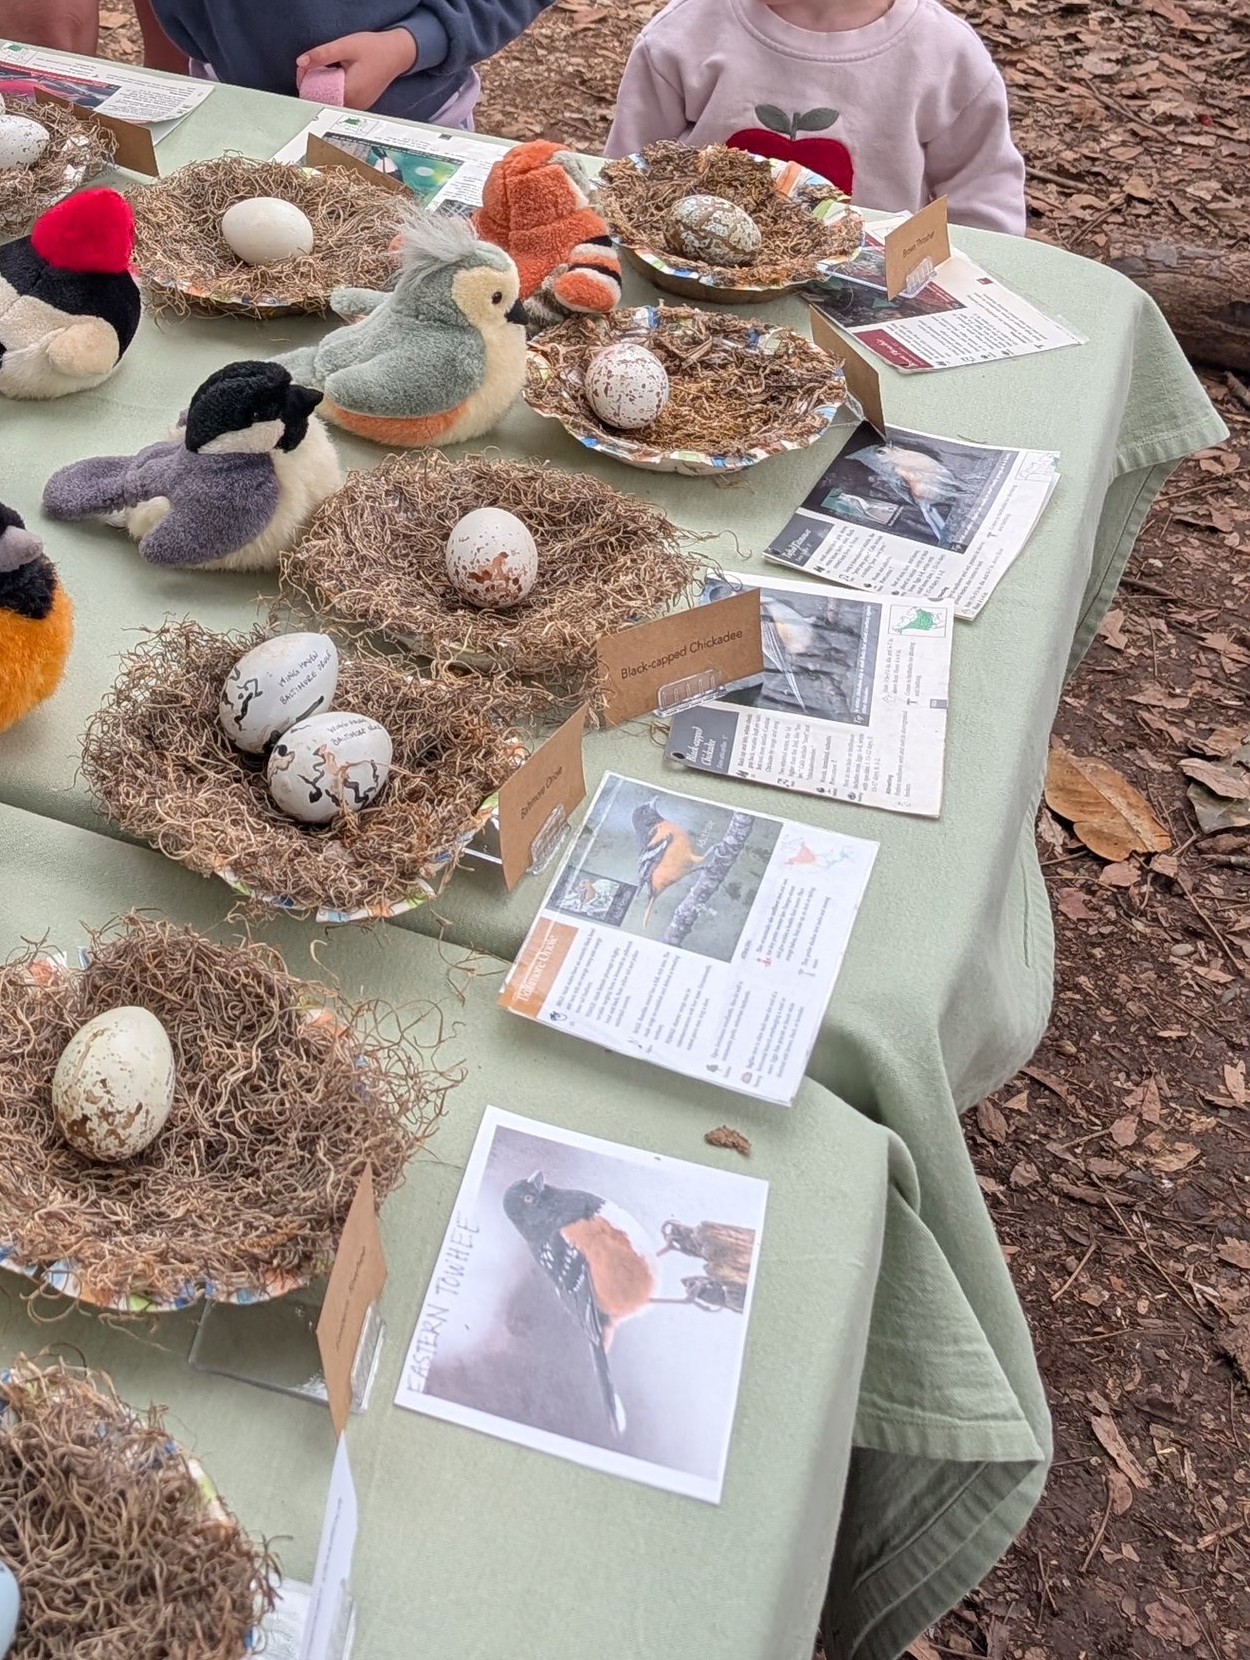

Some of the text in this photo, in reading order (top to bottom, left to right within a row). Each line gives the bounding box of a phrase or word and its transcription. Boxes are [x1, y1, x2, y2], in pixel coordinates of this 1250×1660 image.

[620, 630, 743, 679] Black-capped Chickadee
[407, 1210, 481, 1395] EASTERN TOWHEE
